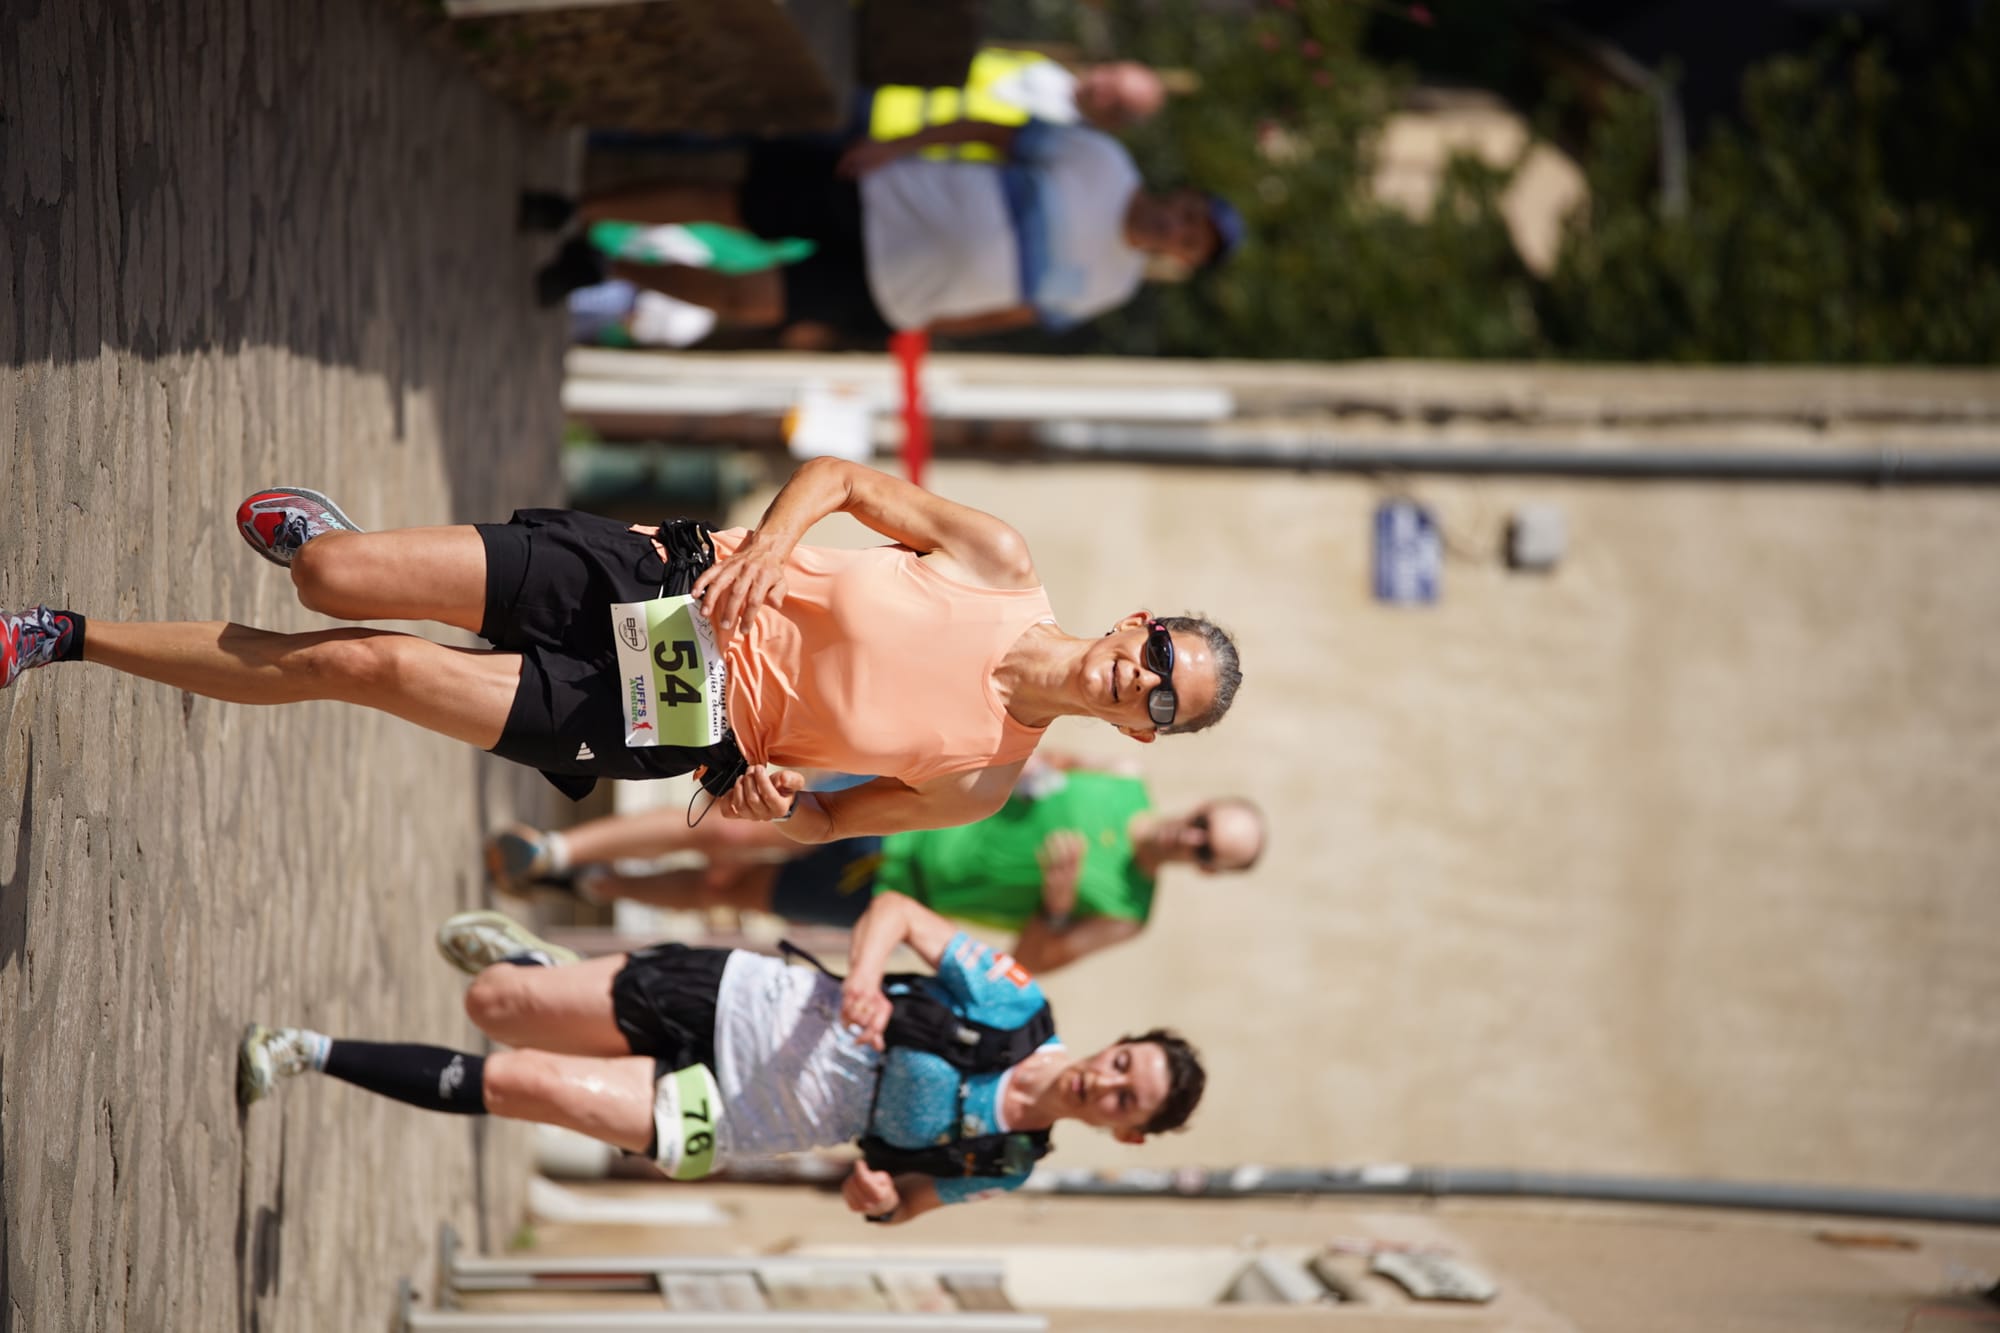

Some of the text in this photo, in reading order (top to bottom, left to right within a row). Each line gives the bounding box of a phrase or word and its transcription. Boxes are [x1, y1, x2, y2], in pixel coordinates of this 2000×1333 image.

[626, 617, 638, 647] BFP
[634, 674, 647, 717] TUFF'S
[654, 640, 702, 707] 54
[629, 678, 638, 722] Aventure
[683, 1098, 713, 1156] 76
